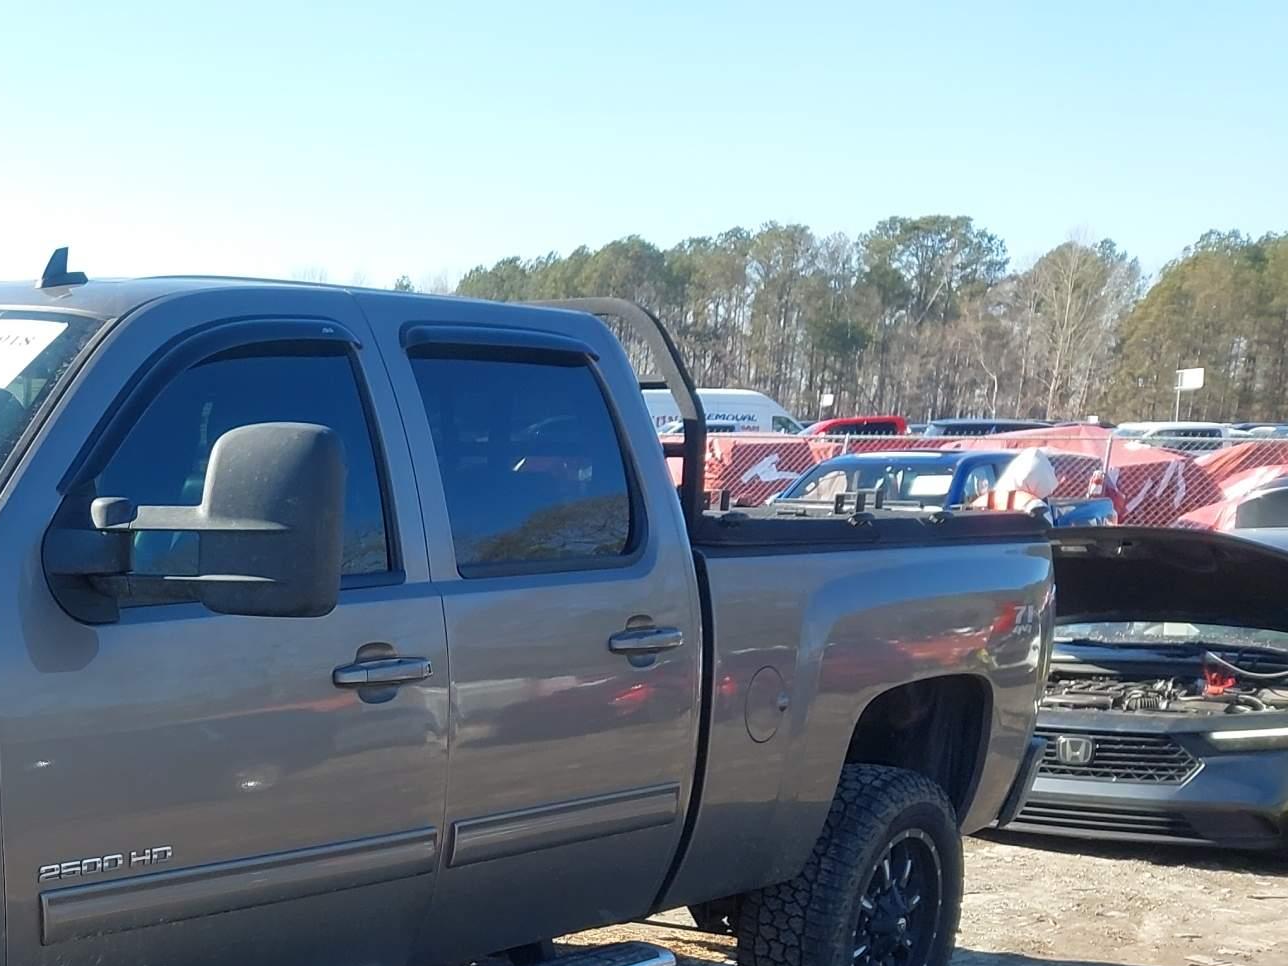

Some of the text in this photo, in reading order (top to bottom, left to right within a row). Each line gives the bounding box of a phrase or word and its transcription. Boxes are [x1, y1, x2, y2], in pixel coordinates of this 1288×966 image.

[706, 413, 757, 422] EMOVAL
[39, 846, 172, 882] 2500 HD
